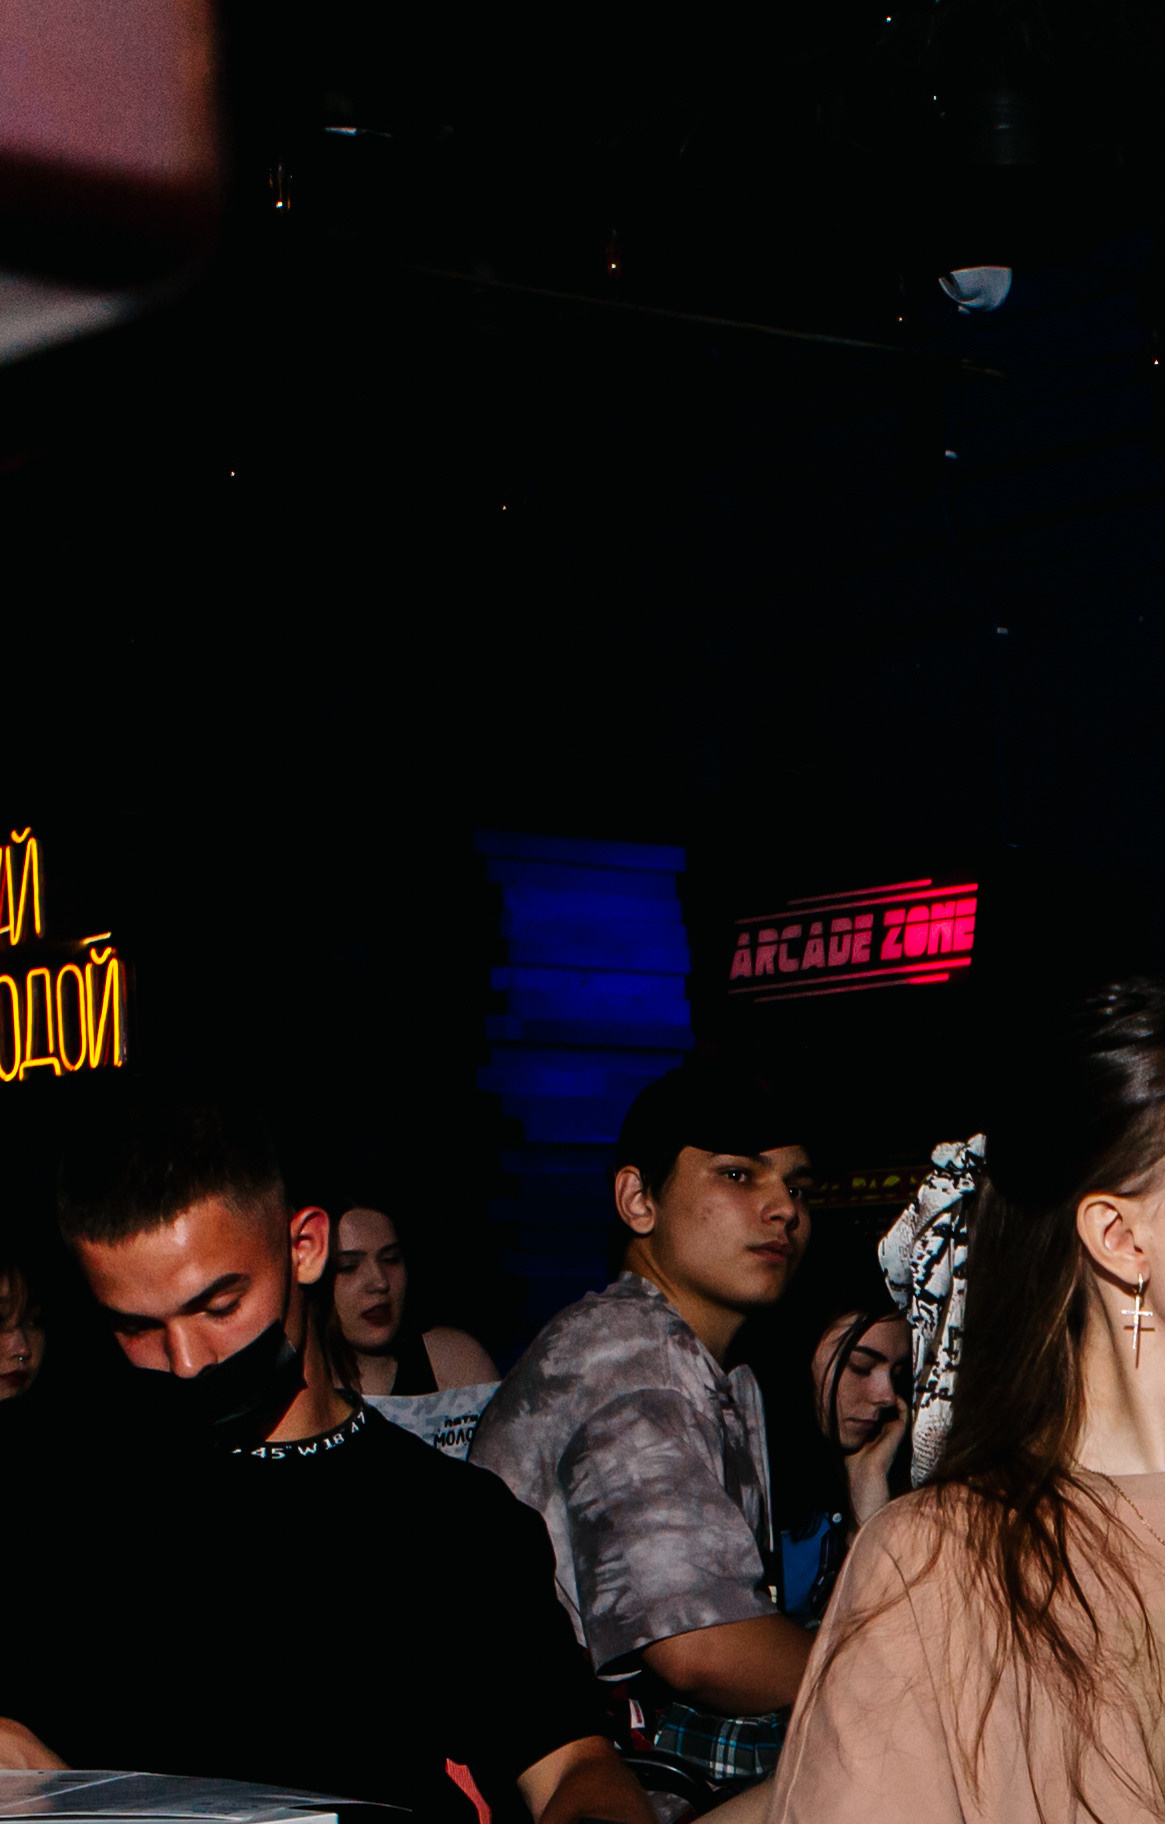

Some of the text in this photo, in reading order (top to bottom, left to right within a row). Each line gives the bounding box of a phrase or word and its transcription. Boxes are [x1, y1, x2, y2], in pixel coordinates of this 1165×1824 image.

[0, 826, 43, 947] Й
[729, 897, 978, 980] ARCADE ZONE
